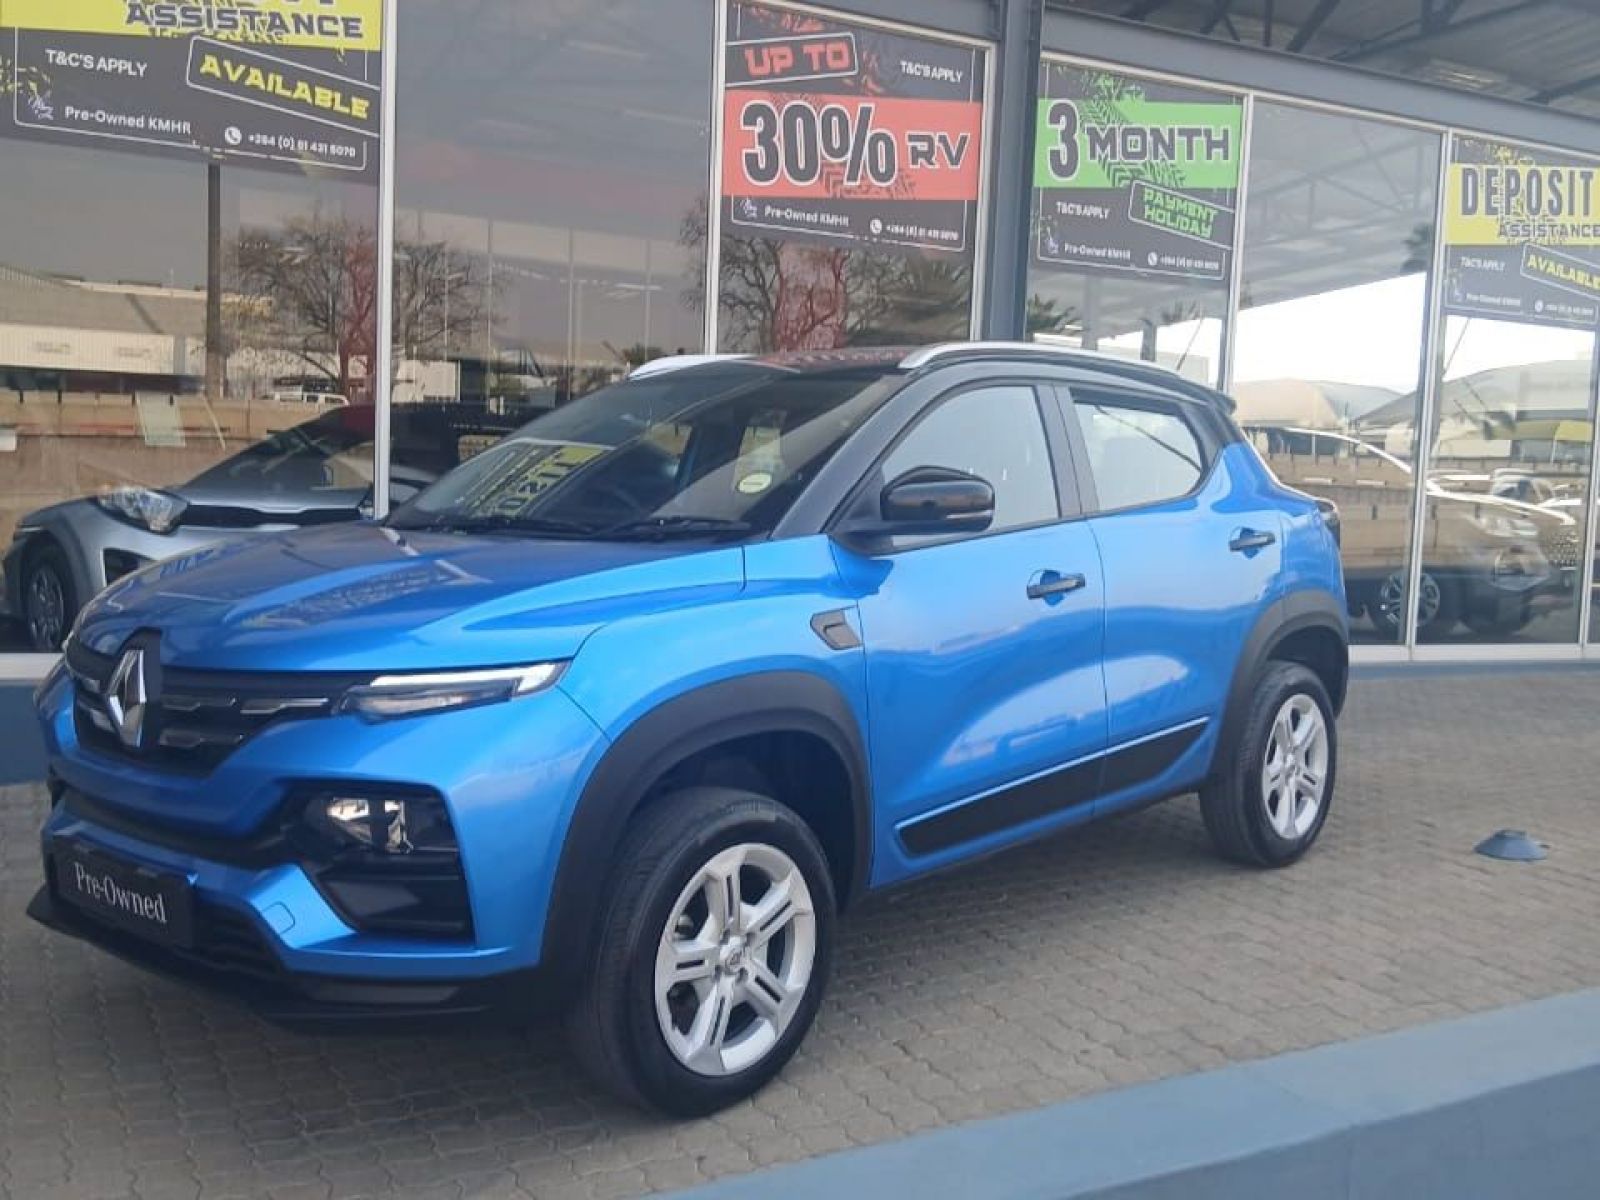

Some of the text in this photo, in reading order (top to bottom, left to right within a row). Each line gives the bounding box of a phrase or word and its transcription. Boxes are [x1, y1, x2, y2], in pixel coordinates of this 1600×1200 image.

[126, 1, 363, 39] ASSISTANCE
[45, 49, 148, 77] T&C'S APPLY
[744, 41, 850, 76] UP TO
[901, 60, 963, 83] T&C'S APPLY
[200, 54, 370, 120] AVAILABLE
[64, 106, 191, 134] Pre-Owned KMHR
[740, 100, 971, 186] 30% RV
[1047, 99, 1232, 181] 3 MONTH
[1144, 187, 1219, 222] PAYMENT
[1461, 167, 1594, 217] DEPOSIT
[765, 204, 818, 222] Pre-Owned
[1144, 205, 1214, 239] HOLIDAY
[1497, 222, 1600, 239] ASSISTANCE
[74, 861, 167, 924] Pre-Owned
